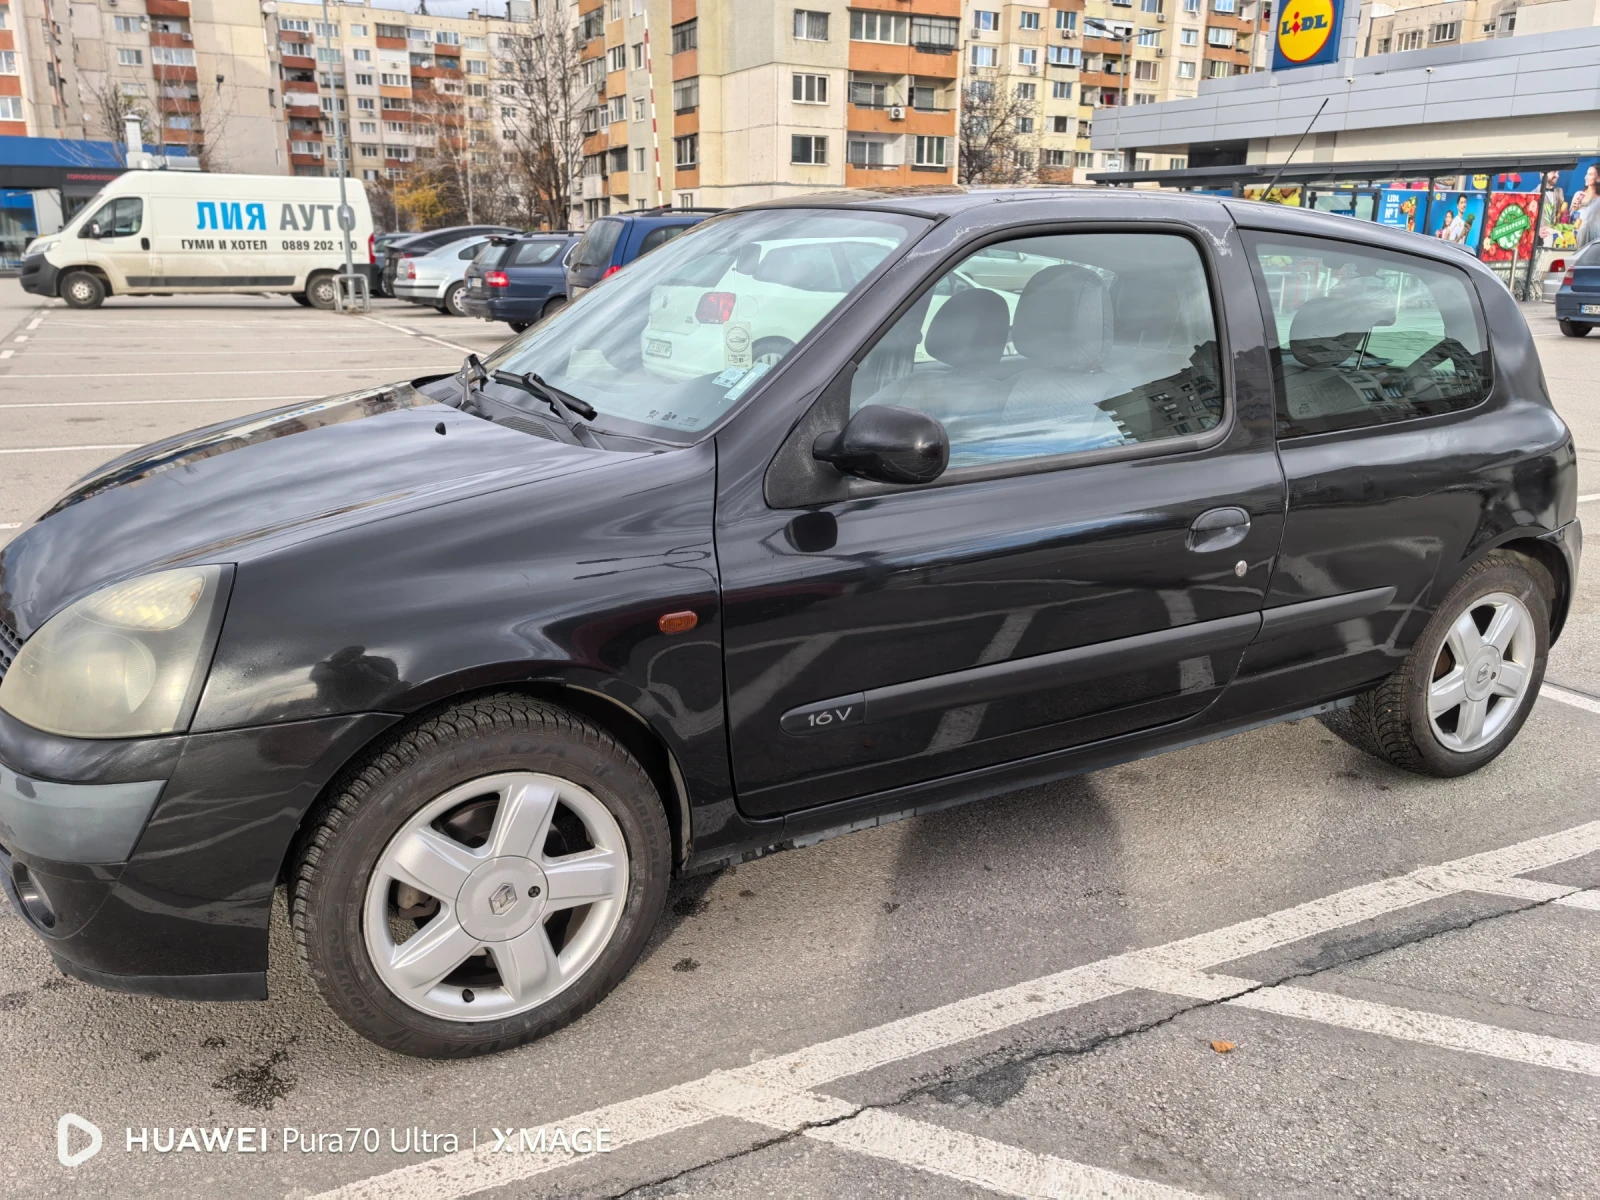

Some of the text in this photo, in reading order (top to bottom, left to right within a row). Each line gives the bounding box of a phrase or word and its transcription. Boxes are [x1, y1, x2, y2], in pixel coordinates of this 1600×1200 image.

[196, 201, 356, 232] ЛИЯ АУТО
[181, 239, 267, 251] ГУМИ И ХОТЕЛ
[282, 240, 357, 251] 0889 202 10
